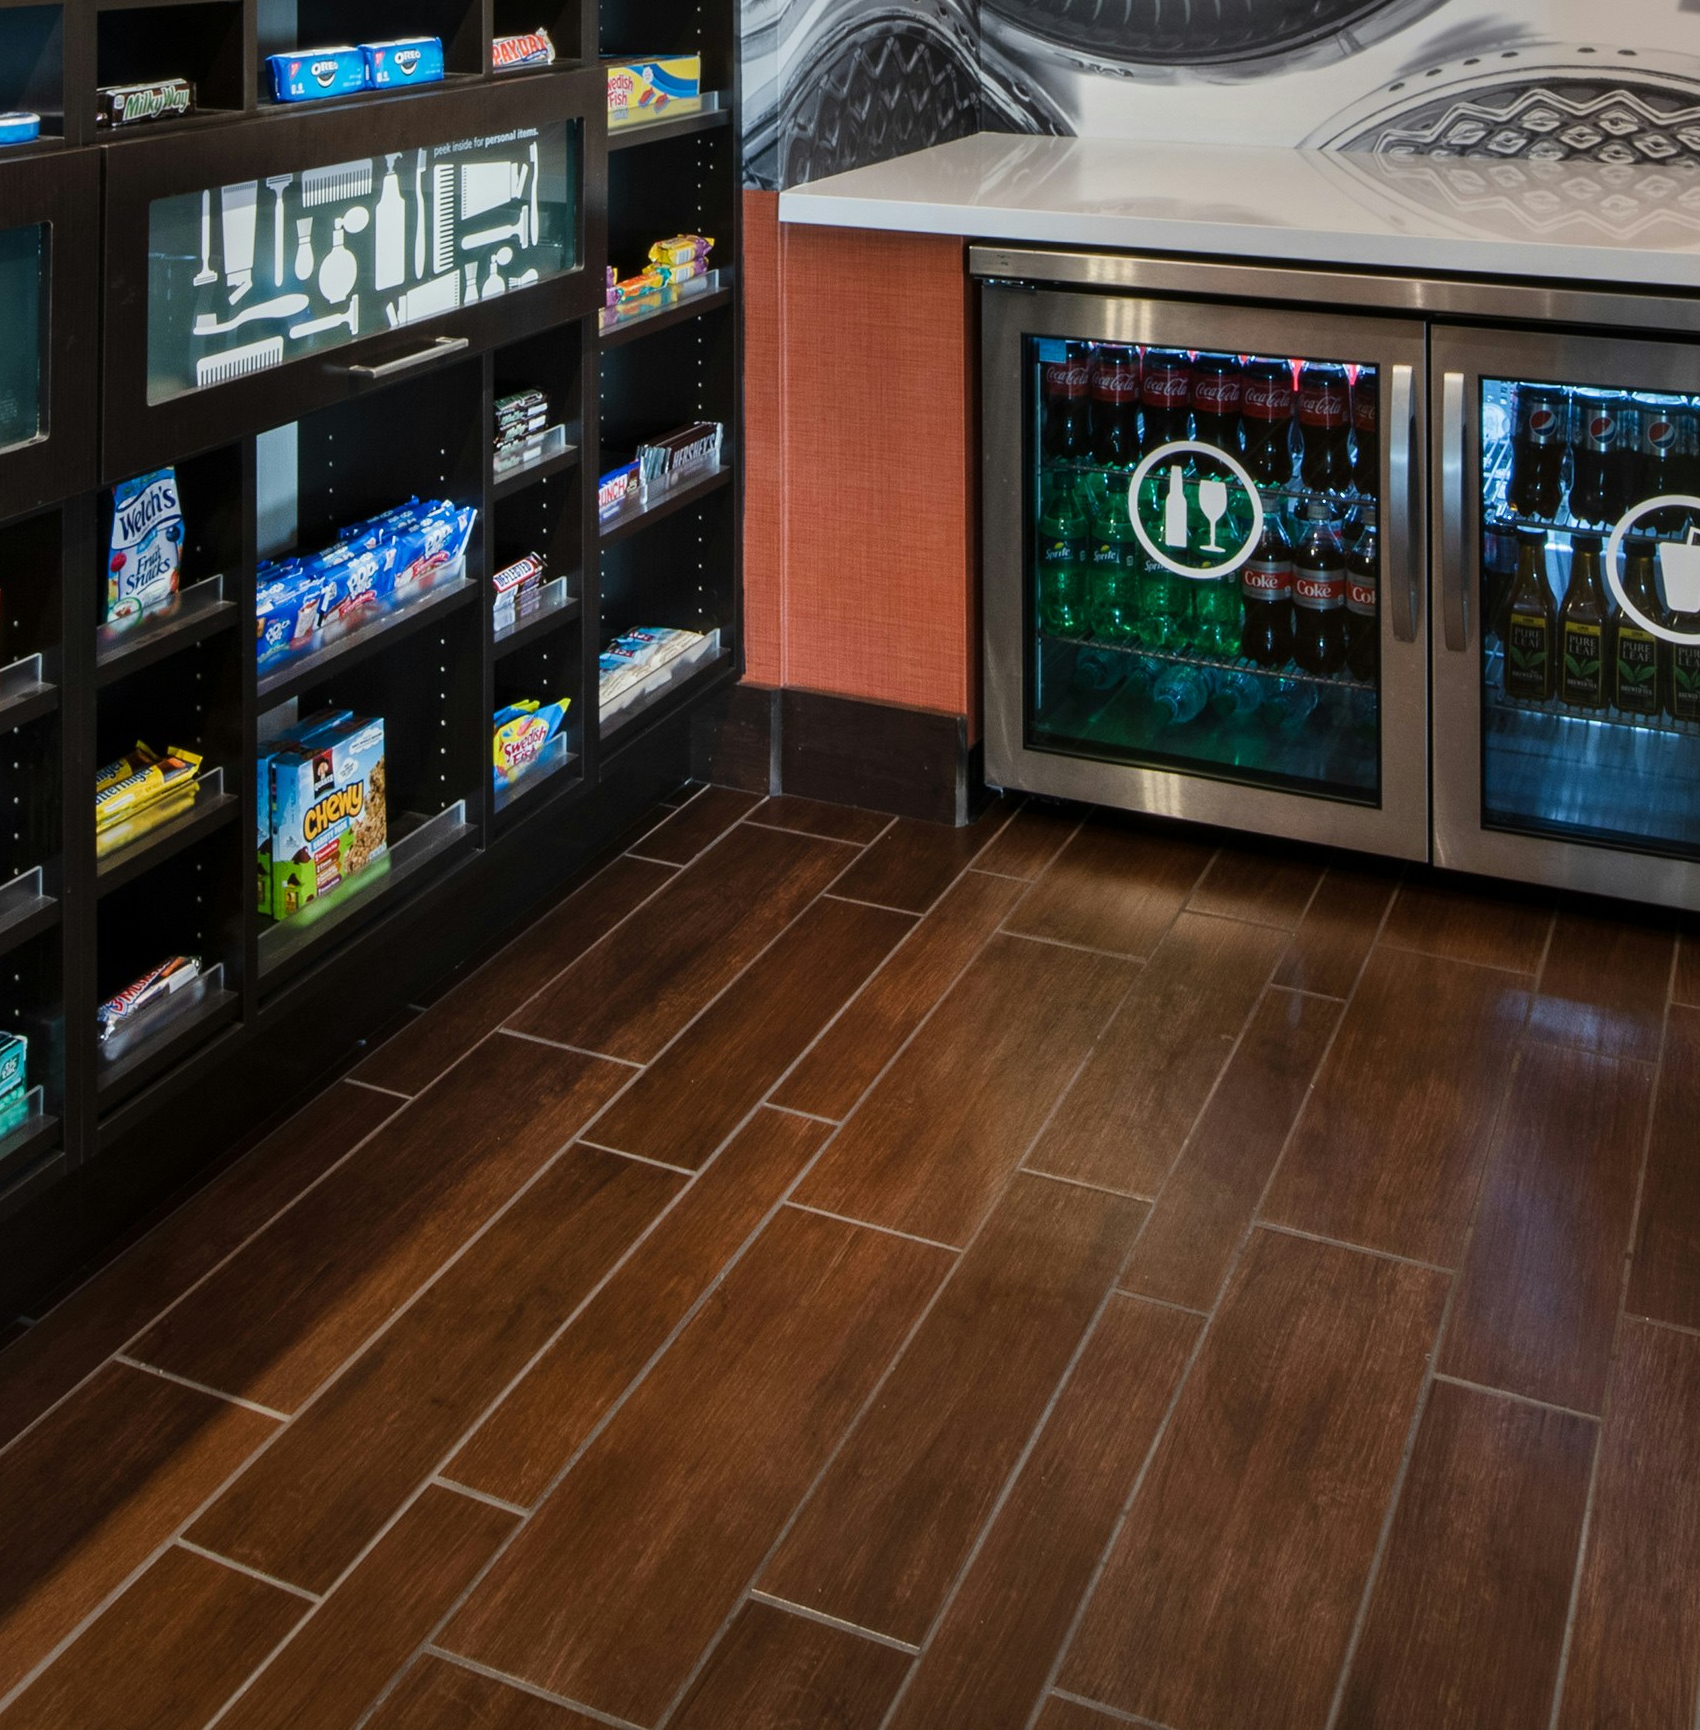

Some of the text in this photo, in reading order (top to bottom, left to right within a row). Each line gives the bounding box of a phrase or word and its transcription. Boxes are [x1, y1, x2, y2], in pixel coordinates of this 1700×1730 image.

[311, 60, 339, 75] OREO
[394, 49, 421, 64] OREO
[433, 143, 452, 158] peek
[453, 138, 473, 154] inside
[473, 136, 484, 151] for
[485, 130, 515, 149] personal
[118, 485, 176, 541] Welch's
[1244, 570, 1279, 590] Coke
[1296, 578, 1332, 600] Coke
[504, 725, 547, 758] Swedish
